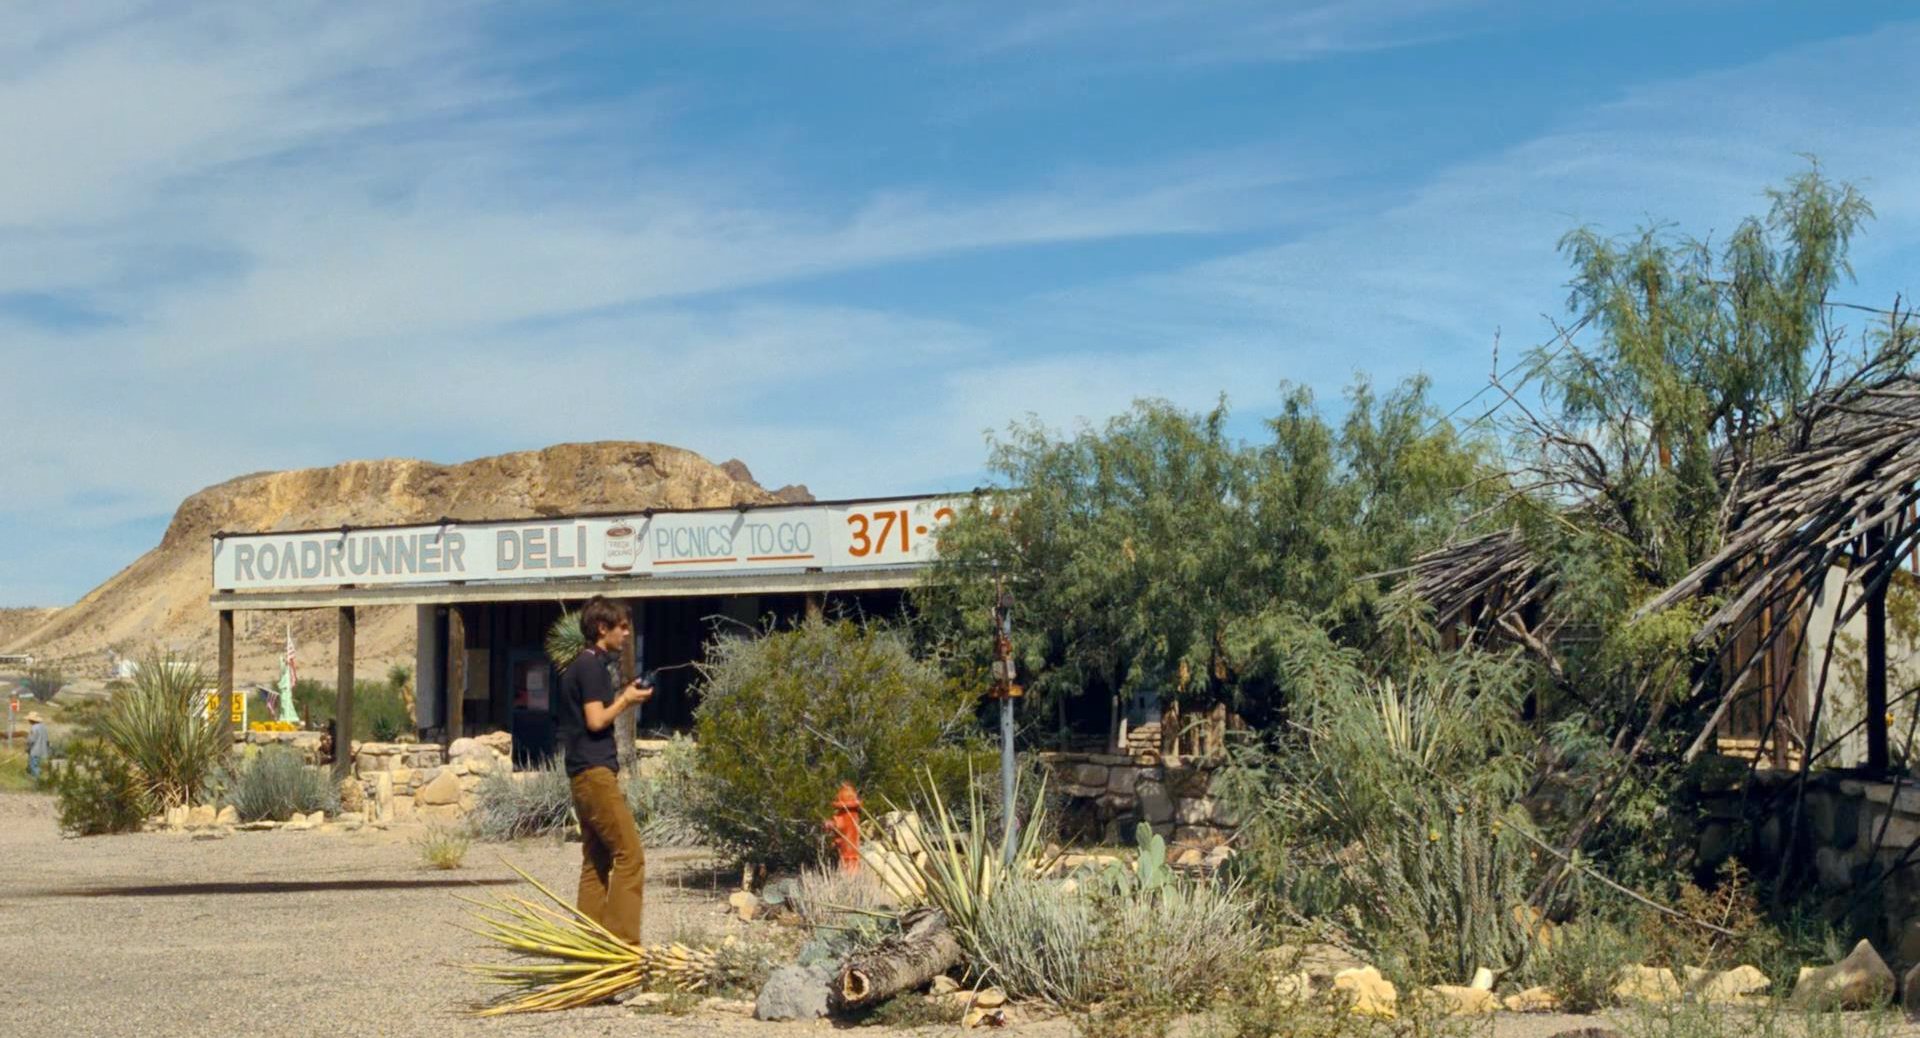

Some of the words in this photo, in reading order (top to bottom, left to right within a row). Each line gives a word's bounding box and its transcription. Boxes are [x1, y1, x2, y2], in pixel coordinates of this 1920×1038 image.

[234, 531, 466, 581] ROADRUNNER
[496, 525, 588, 572] DELI
[656, 525, 734, 558] PICNICS
[744, 522, 775, 555] TO
[777, 521, 811, 553] GO
